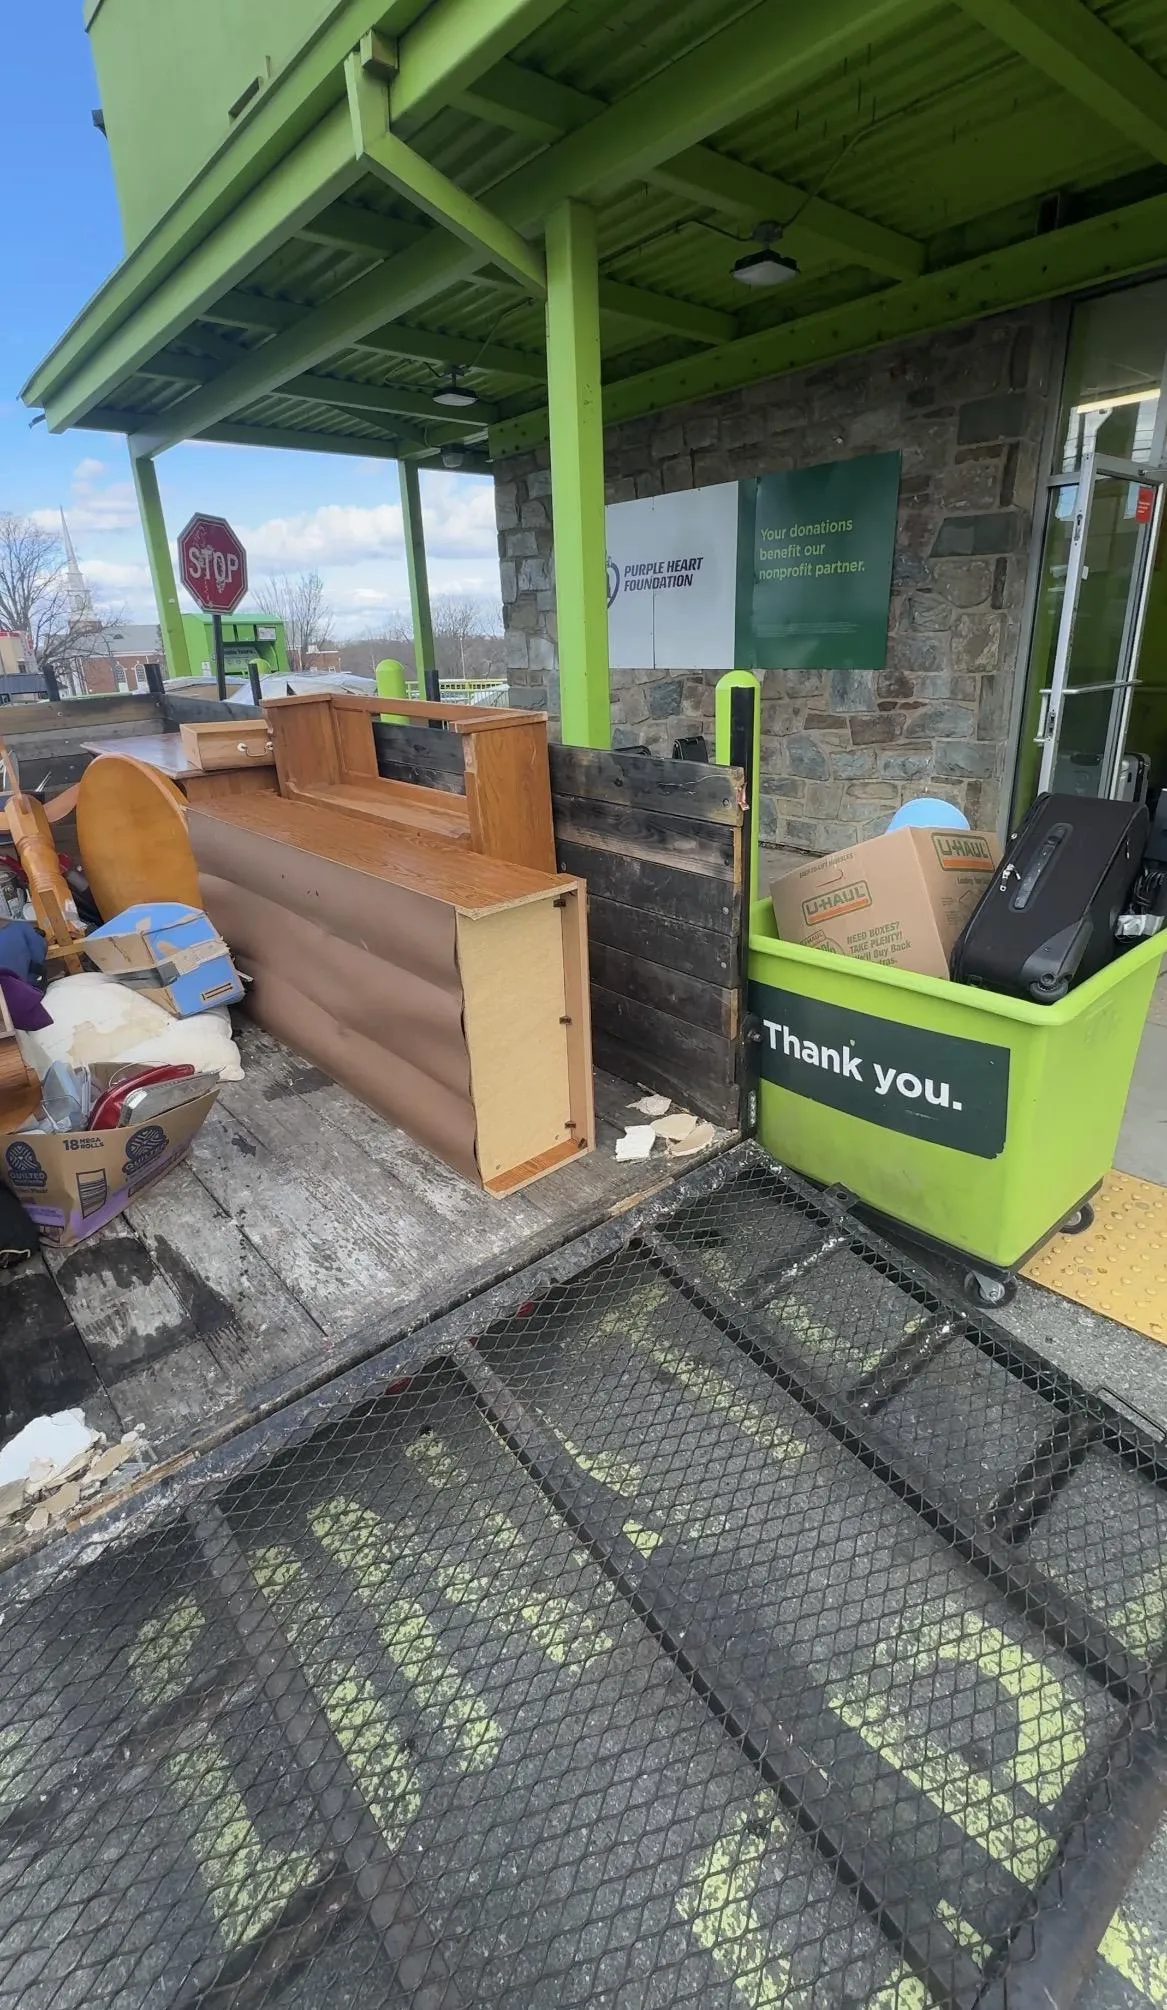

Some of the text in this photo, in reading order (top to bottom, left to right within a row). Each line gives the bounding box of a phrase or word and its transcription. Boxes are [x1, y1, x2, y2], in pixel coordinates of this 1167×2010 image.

[760, 519, 853, 541] Your donations
[760, 544, 826, 561] benefit our
[188, 547, 239, 584] STOP
[624, 557, 704, 578] PURPLE HEART
[759, 560, 865, 581] nonprofit partner.
[624, 573, 693, 592] FOUNDATION
[937, 839, 989, 858] U-HAUL
[806, 886, 866, 915] U-HAUL
[847, 921, 900, 944] NEED BOXES?
[850, 941, 869, 954] TAKE
[871, 931, 902, 948] PLENTY!
[873, 948, 888, 959] Buy
[890, 940, 912, 953] Back
[763, 1019, 963, 1111] Thank you.
[63, 1139, 79, 1150] 18
[10, 1172, 45, 1180] QUILTED
